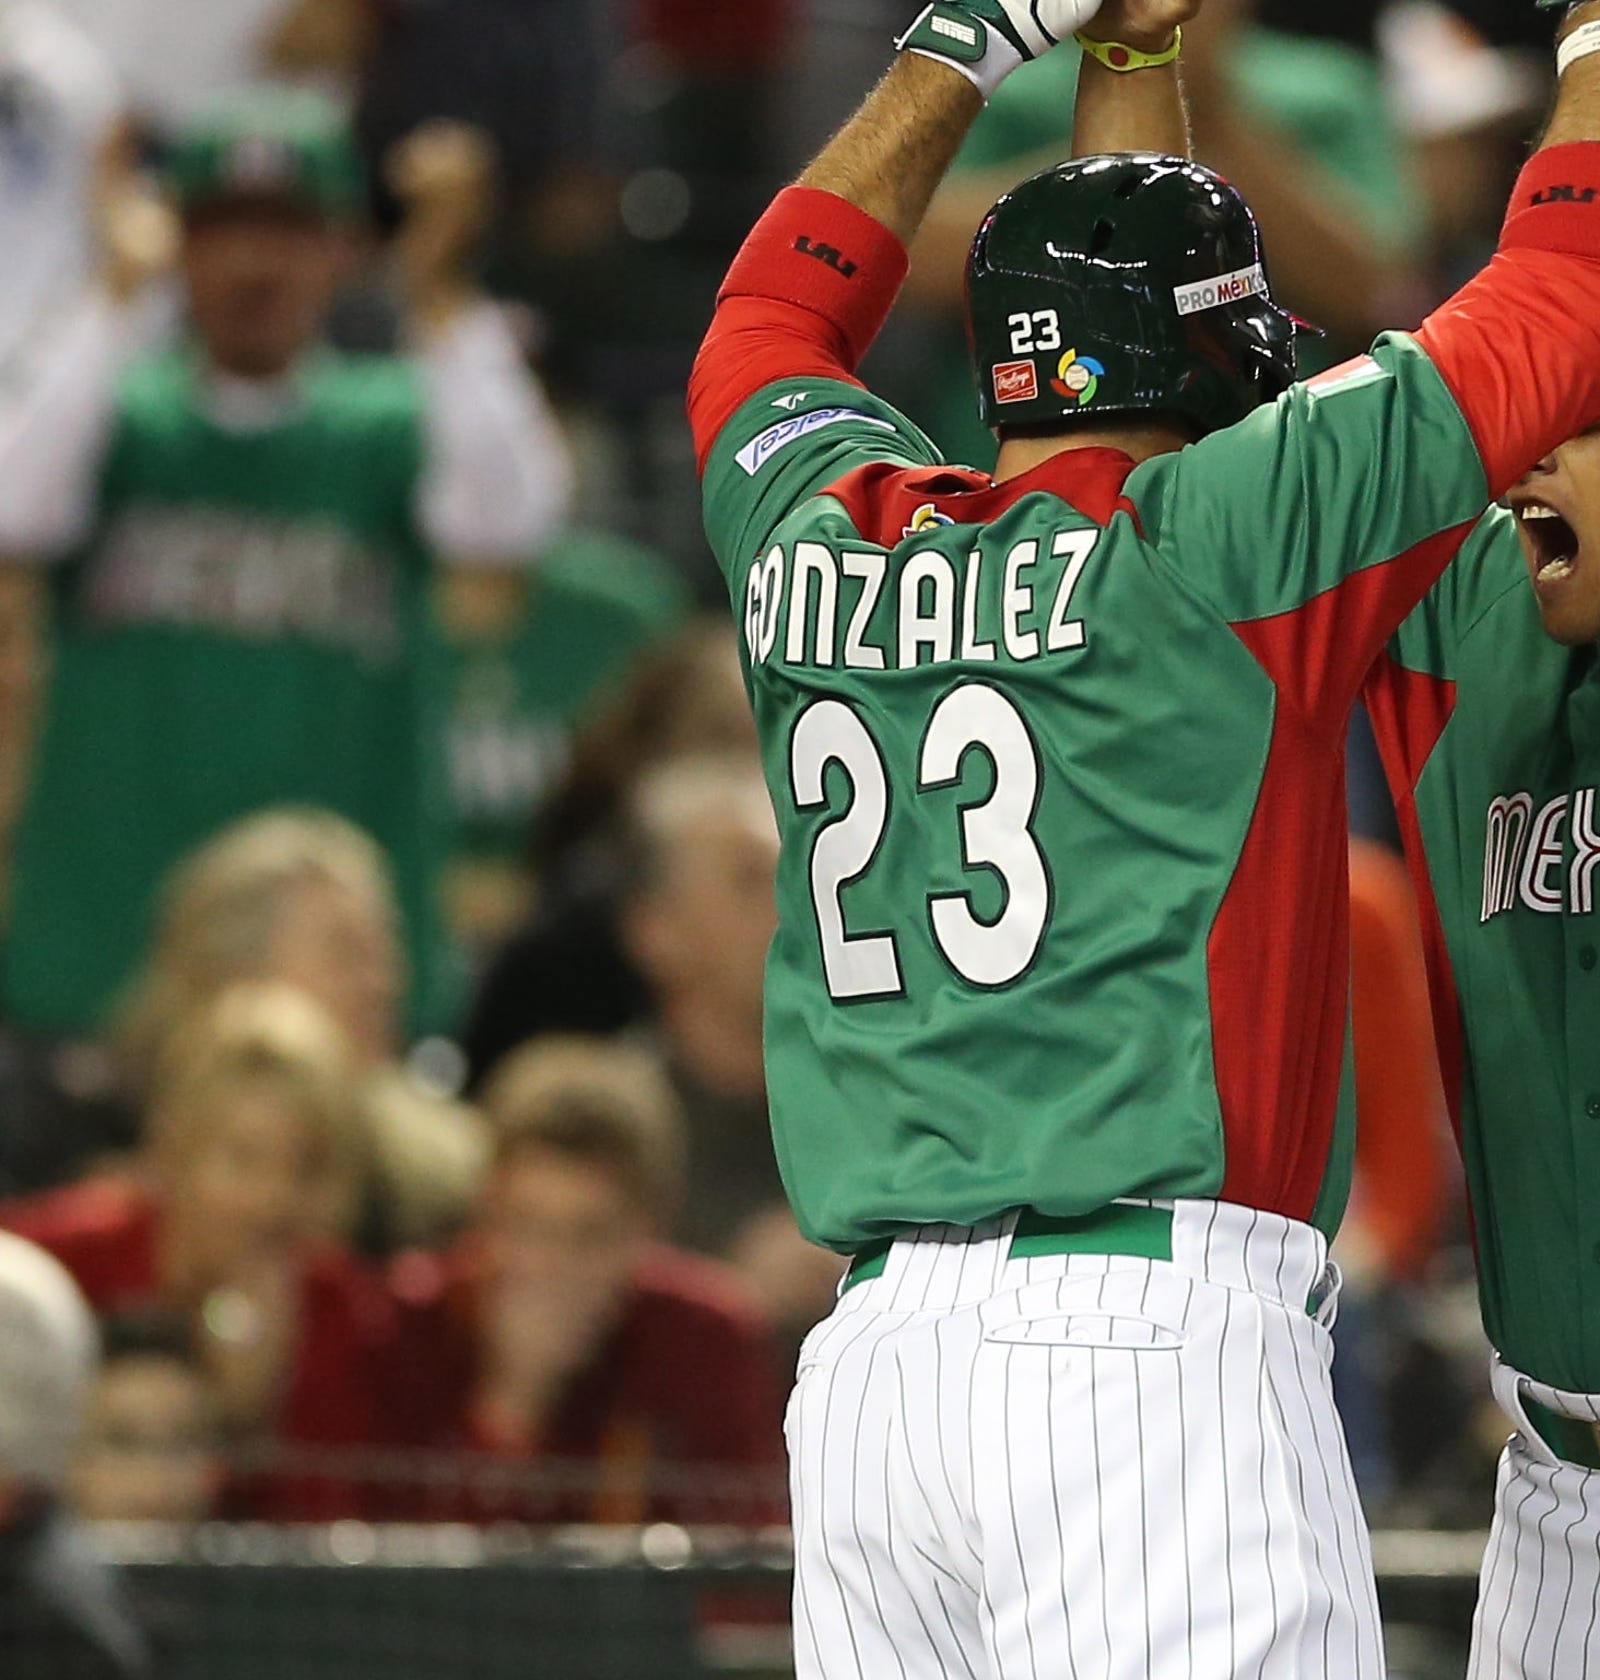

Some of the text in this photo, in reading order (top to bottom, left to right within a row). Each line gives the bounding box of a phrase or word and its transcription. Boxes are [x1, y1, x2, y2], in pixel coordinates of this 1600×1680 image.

[1008, 309, 1061, 354] 23
[745, 528, 1099, 670] GONZALEZ
[790, 680, 1052, 1002] 23
